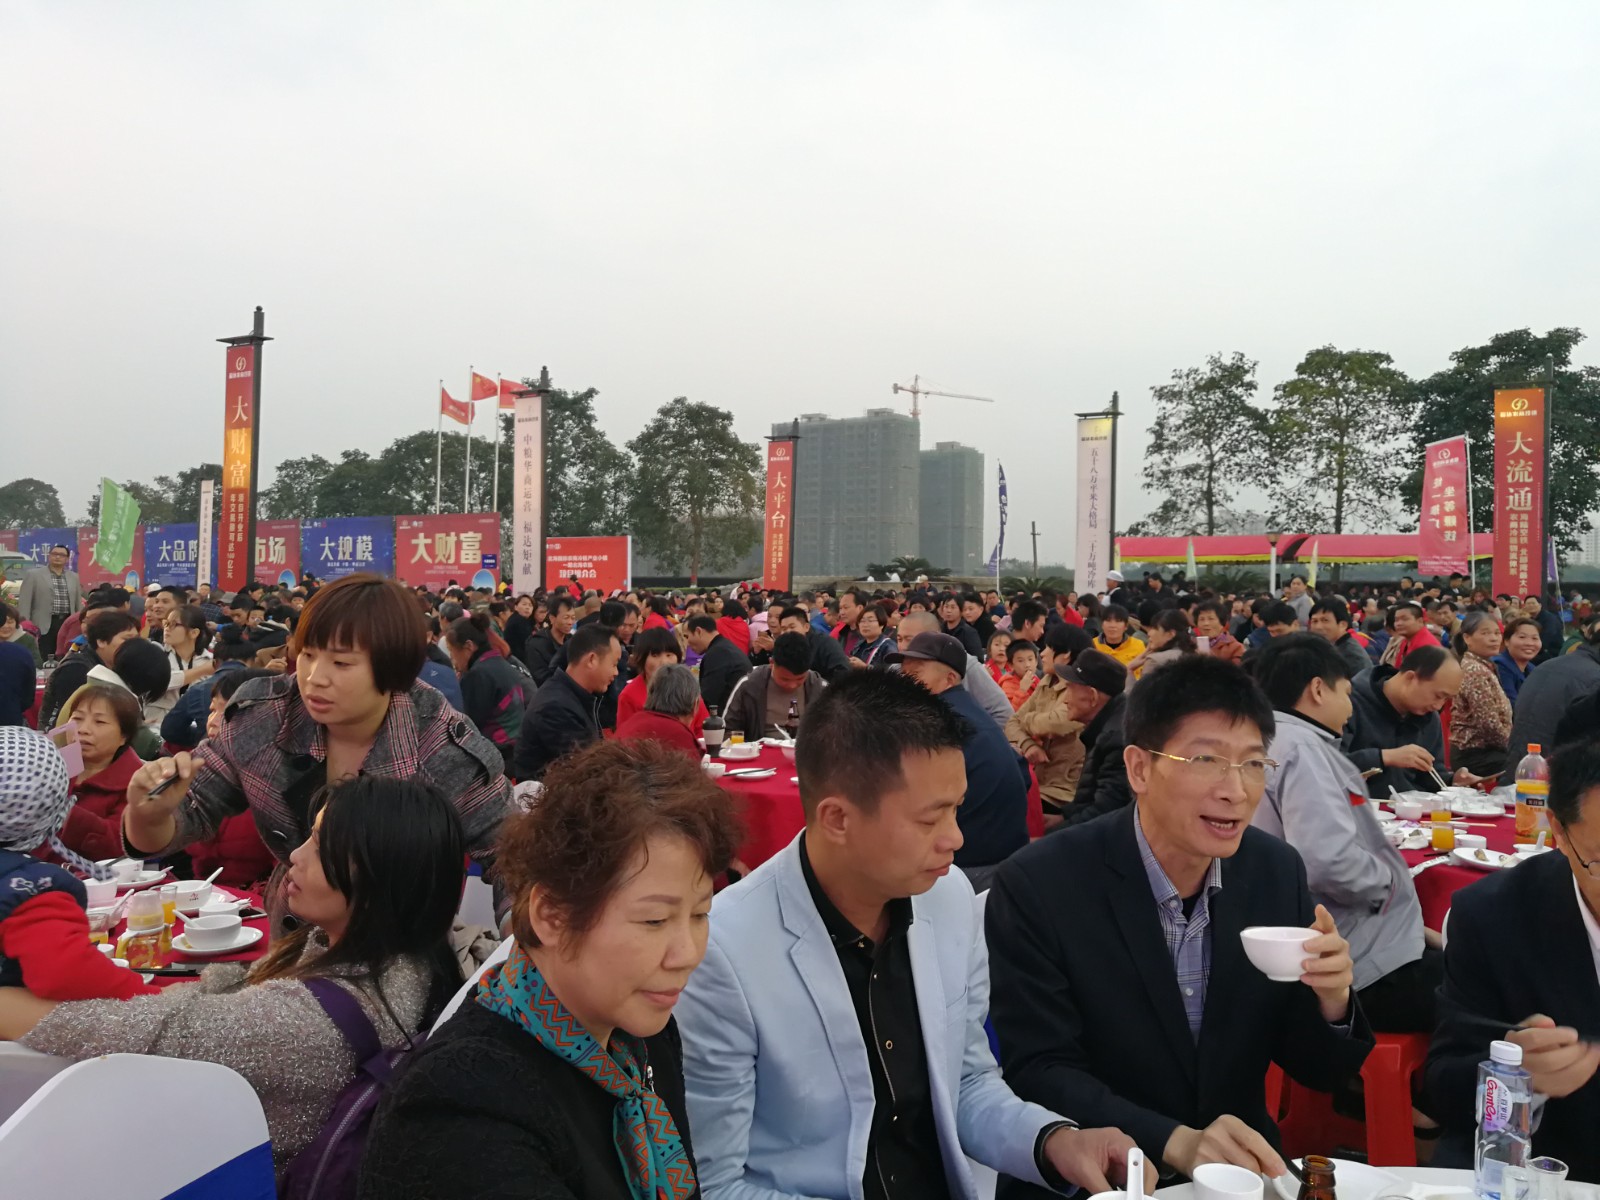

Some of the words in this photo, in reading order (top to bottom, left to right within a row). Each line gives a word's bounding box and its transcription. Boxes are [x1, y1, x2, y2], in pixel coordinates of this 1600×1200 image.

[231, 395, 248, 488] 大财富
[1506, 431, 1534, 511] 大流通
[771, 471, 787, 528] 大平台
[1088, 448, 1098, 529] 五十八万平米大格局
[320, 535, 374, 561] 大规模
[410, 531, 482, 564] 大财富
